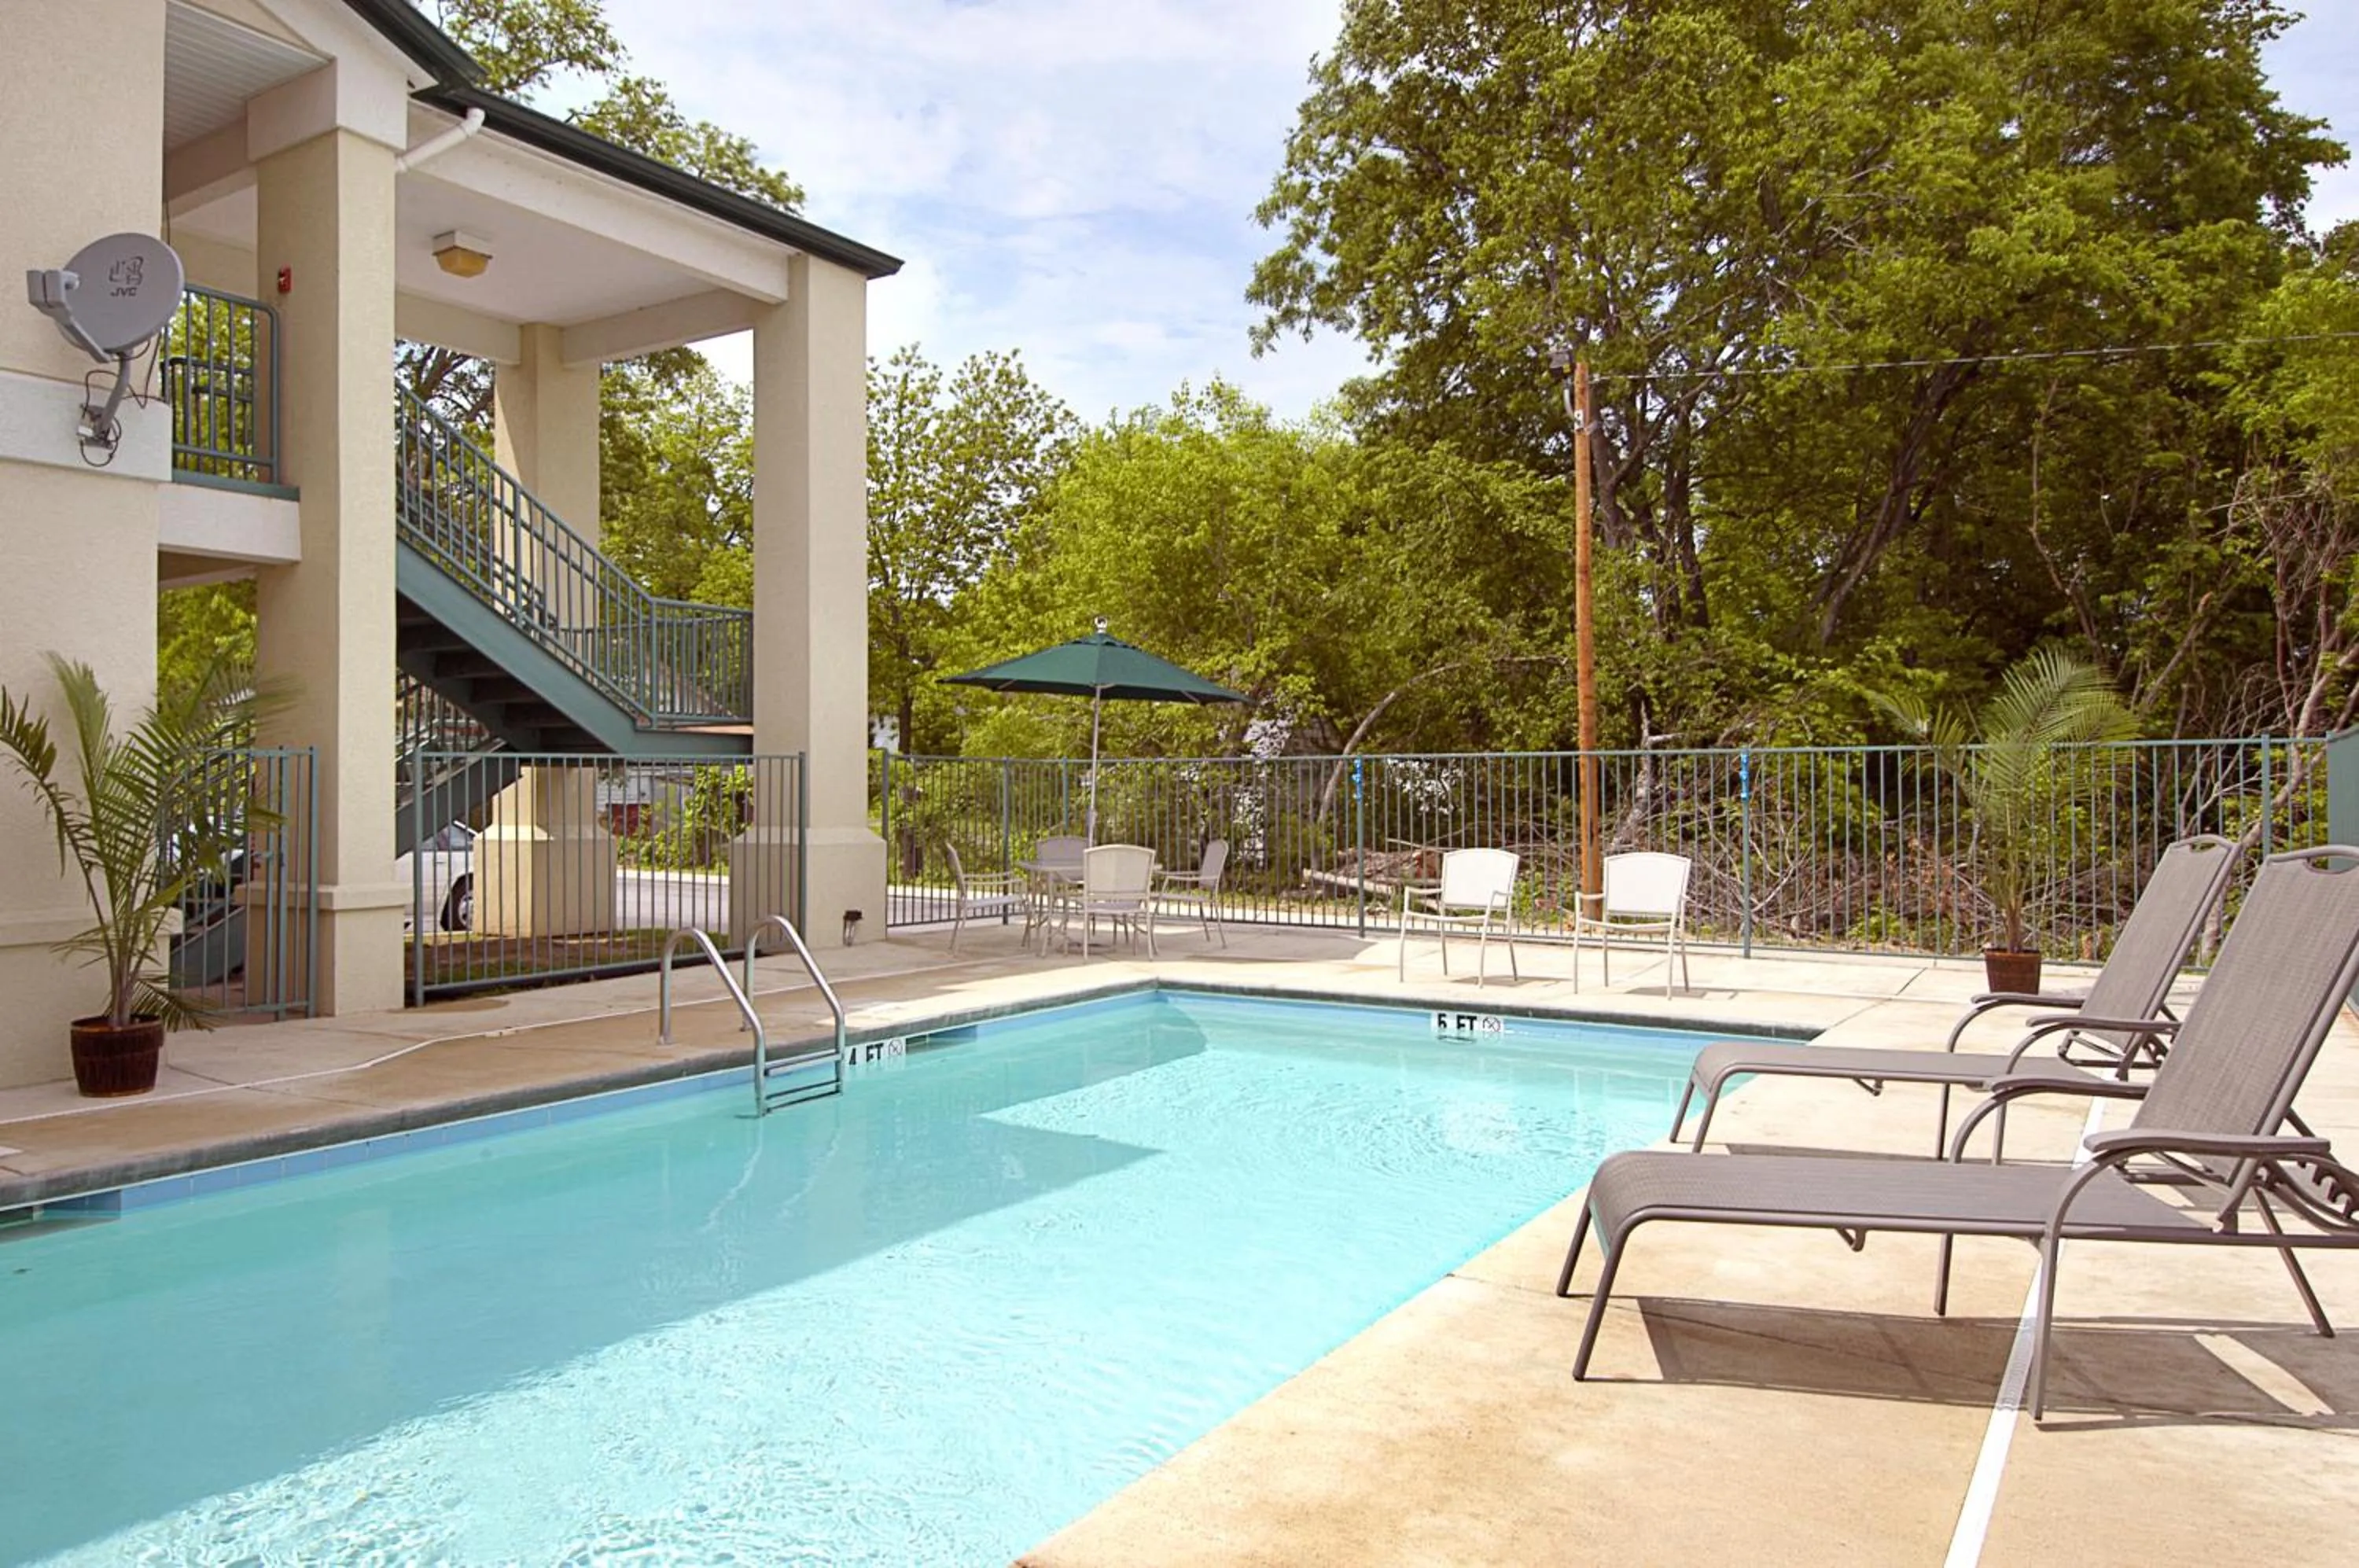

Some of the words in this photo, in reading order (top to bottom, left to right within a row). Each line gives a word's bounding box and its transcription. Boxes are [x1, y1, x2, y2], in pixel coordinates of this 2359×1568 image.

[109, 286, 138, 297] JVC
[1456, 1014, 1478, 1031] FT
[866, 1042, 885, 1062] FT
